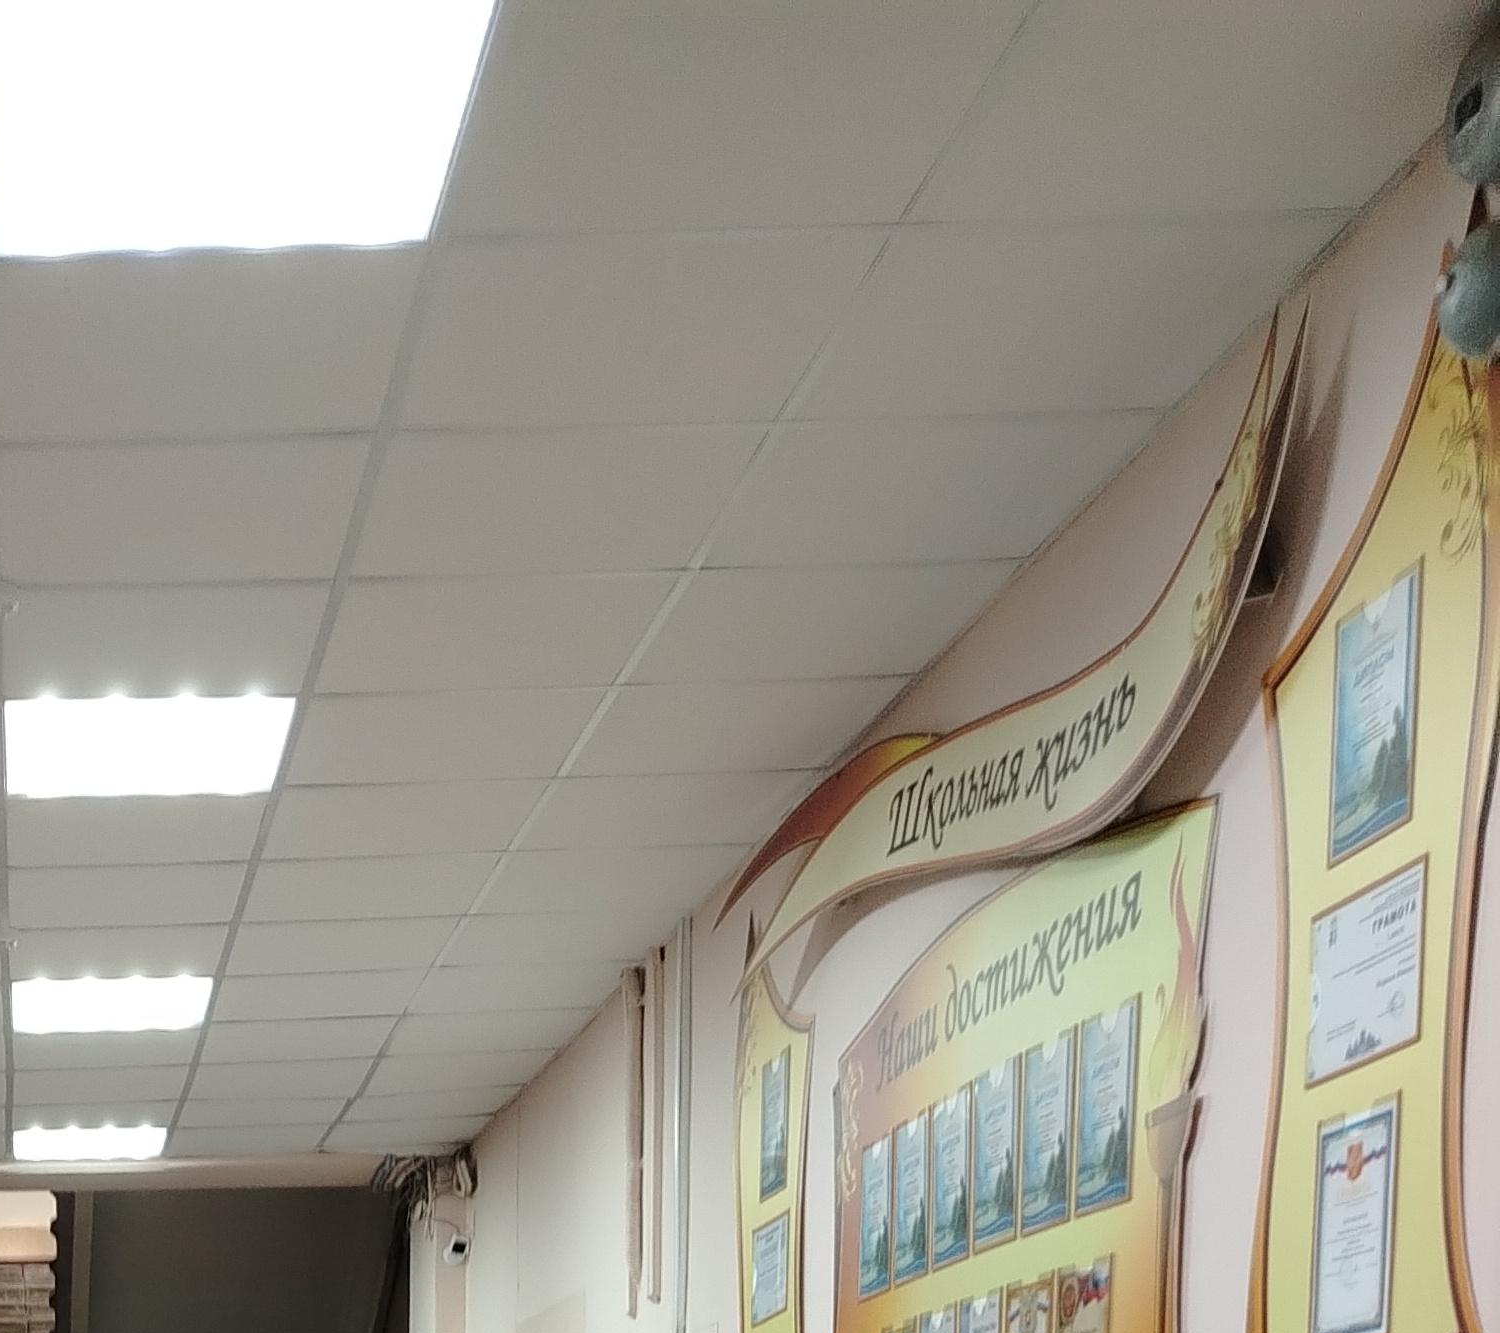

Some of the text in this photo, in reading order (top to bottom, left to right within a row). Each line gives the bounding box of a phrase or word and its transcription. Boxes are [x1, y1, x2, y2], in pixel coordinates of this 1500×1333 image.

[886, 747, 1026, 858] Школьная
[877, 870, 1142, 1093] Наши достижения
